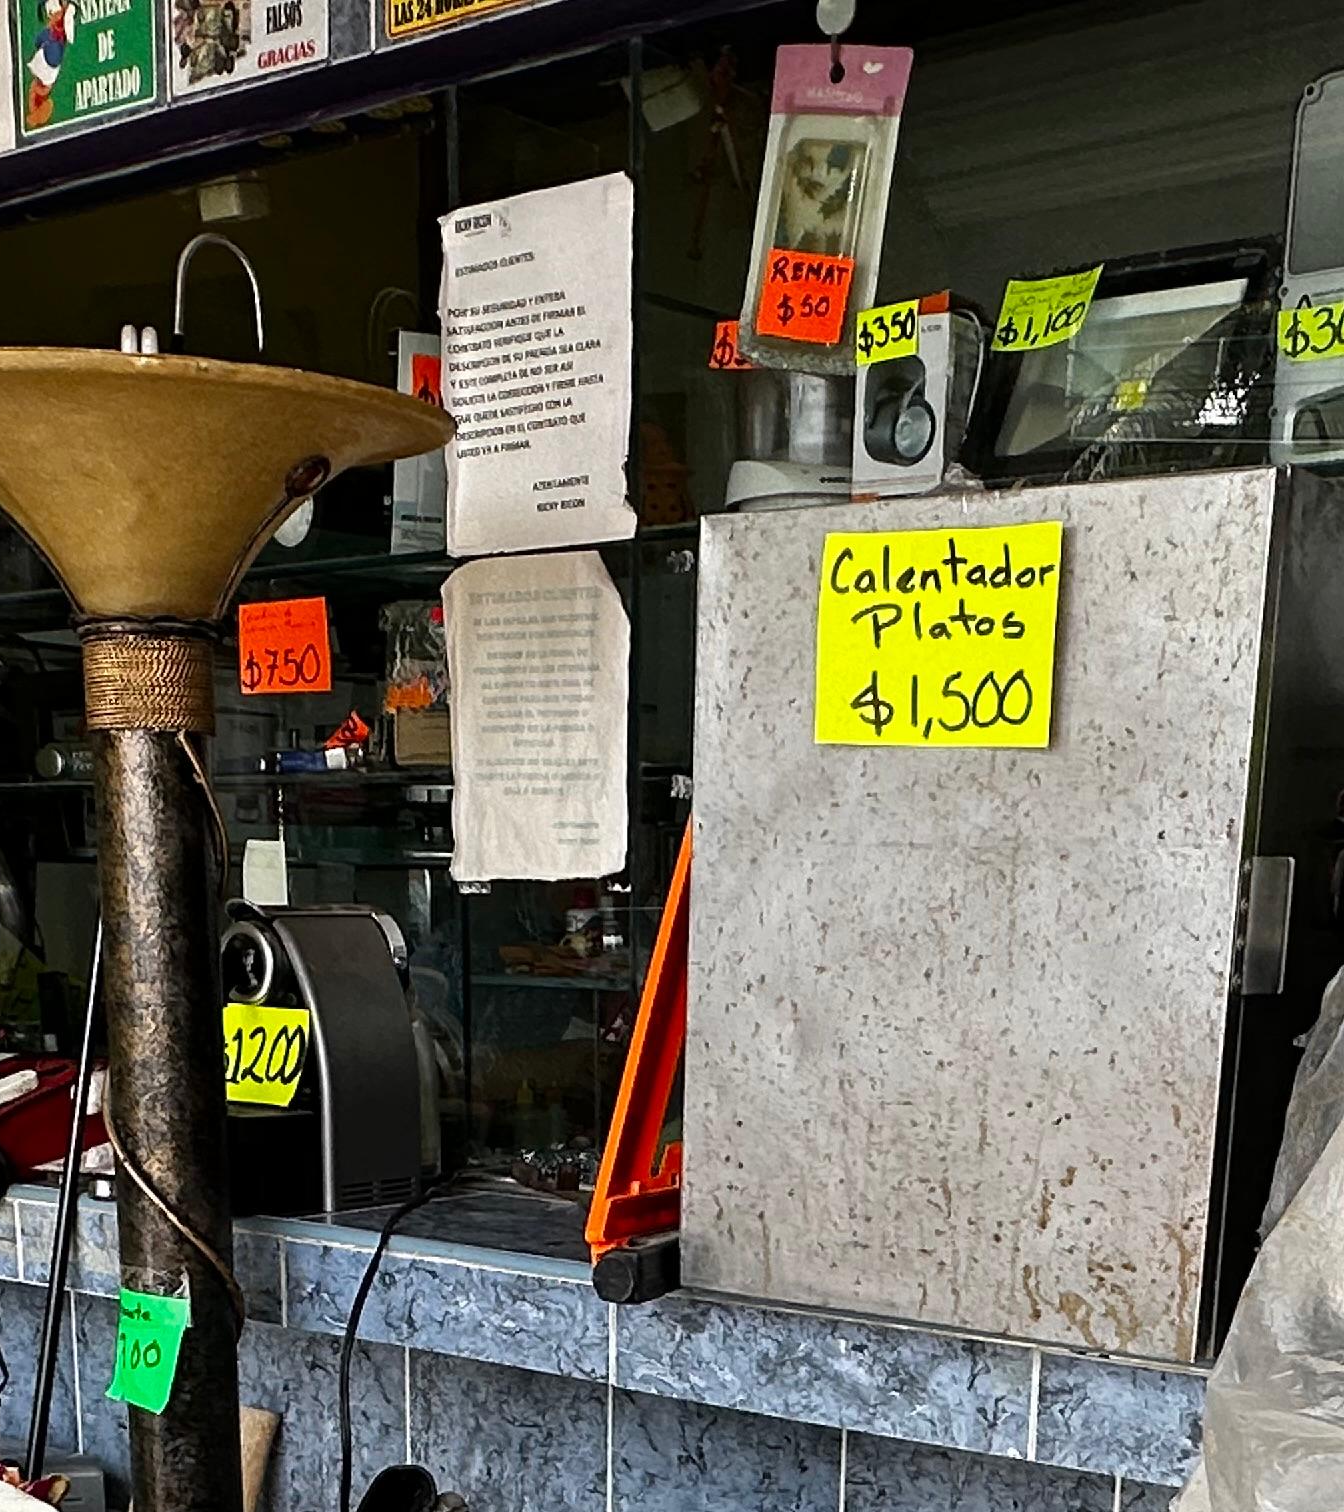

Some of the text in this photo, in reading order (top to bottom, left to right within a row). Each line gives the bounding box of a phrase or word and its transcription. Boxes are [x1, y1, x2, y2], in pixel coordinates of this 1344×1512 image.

[266, 2, 303, 35] FALSOS
[394, 3, 413, 27] LAS
[96, 29, 116, 63] DE
[257, 39, 316, 70] GRACIAS
[74, 65, 142, 112] APARTADO
[770, 256, 849, 286] REMAT
[858, 307, 916, 357] $350
[996, 301, 1086, 348] $1,100
[830, 537, 1056, 595] Calentador
[850, 598, 1026, 650] Platos
[242, 643, 321, 691] $750
[849, 668, 1033, 740] $1,500
